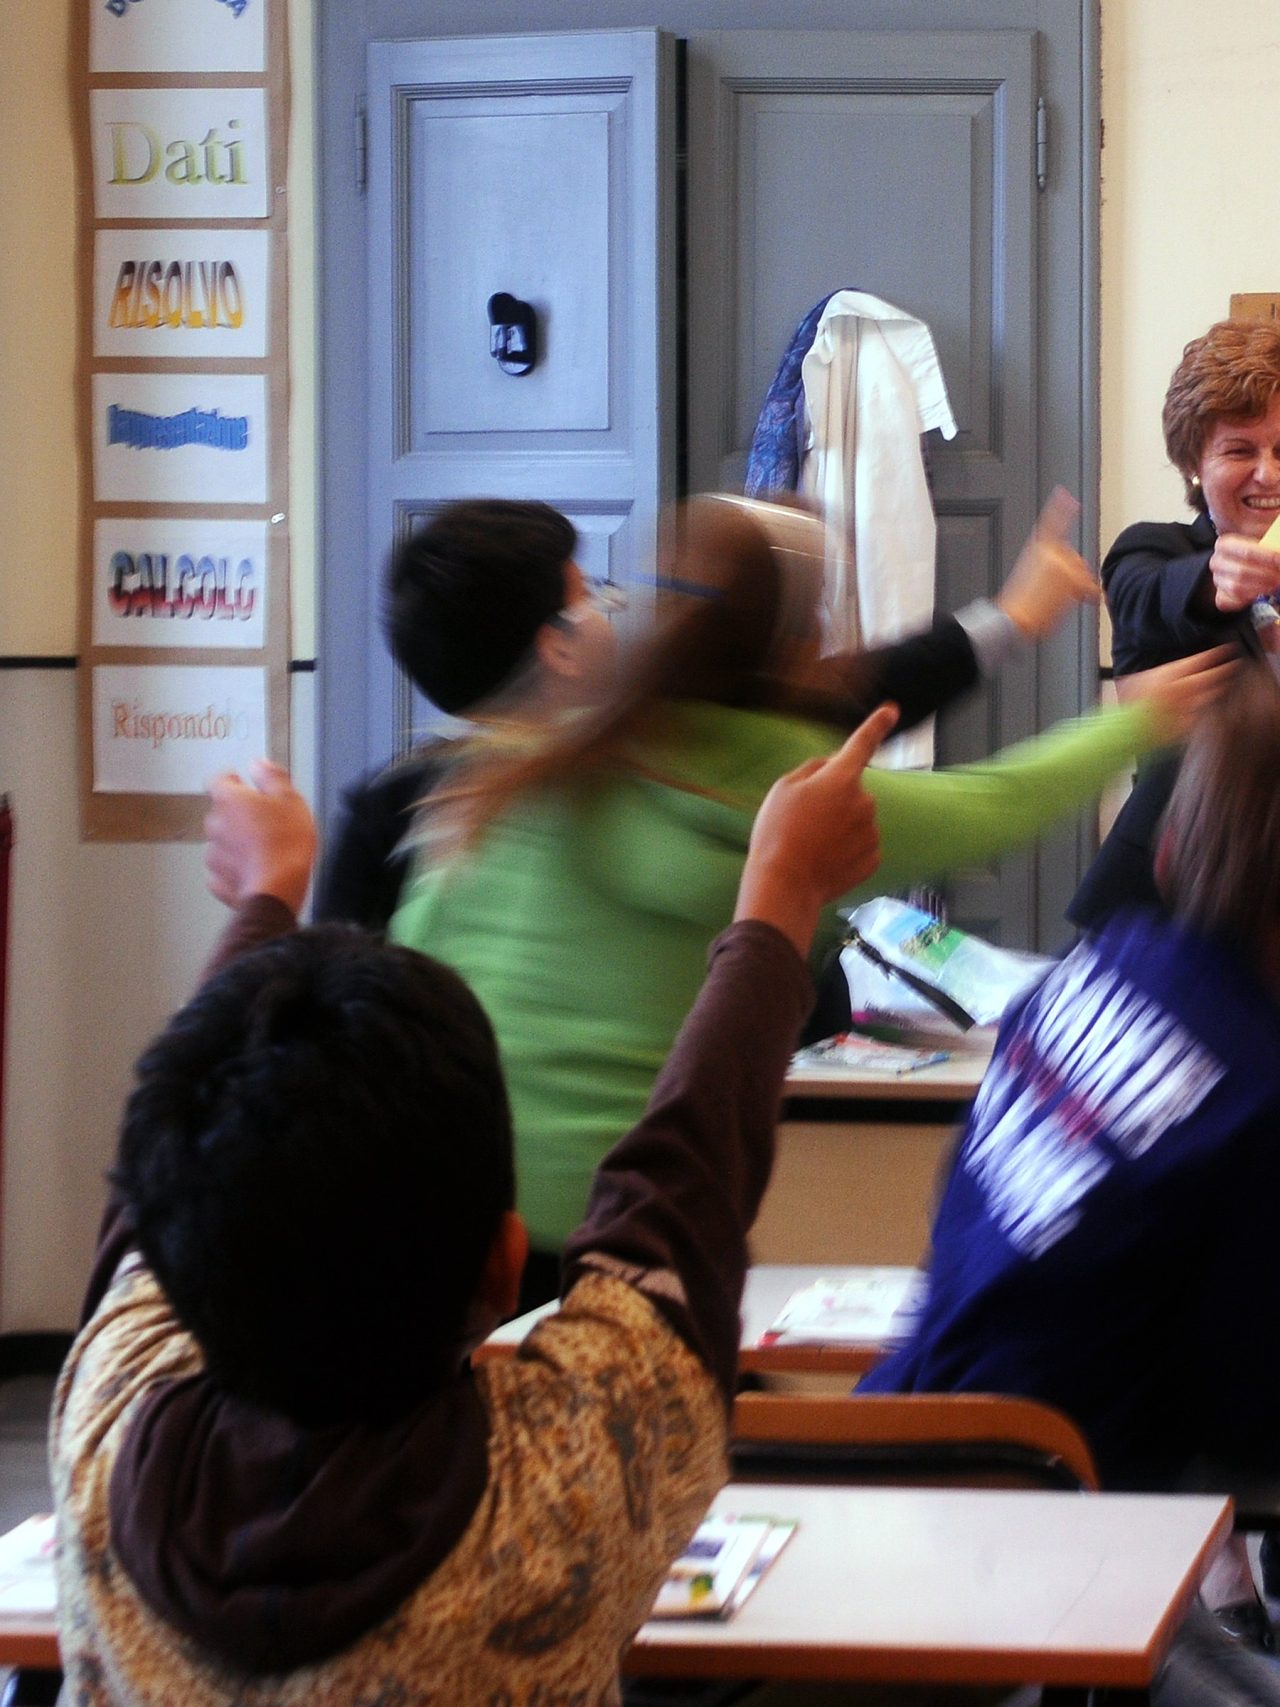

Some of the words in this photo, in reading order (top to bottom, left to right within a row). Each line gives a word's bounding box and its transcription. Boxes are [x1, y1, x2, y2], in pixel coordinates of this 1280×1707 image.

[105, 118, 250, 187] Dati
[108, 259, 245, 330] RISOLVO
[107, 549, 258, 621] CALCOLO
[111, 700, 232, 749] Rispondo
